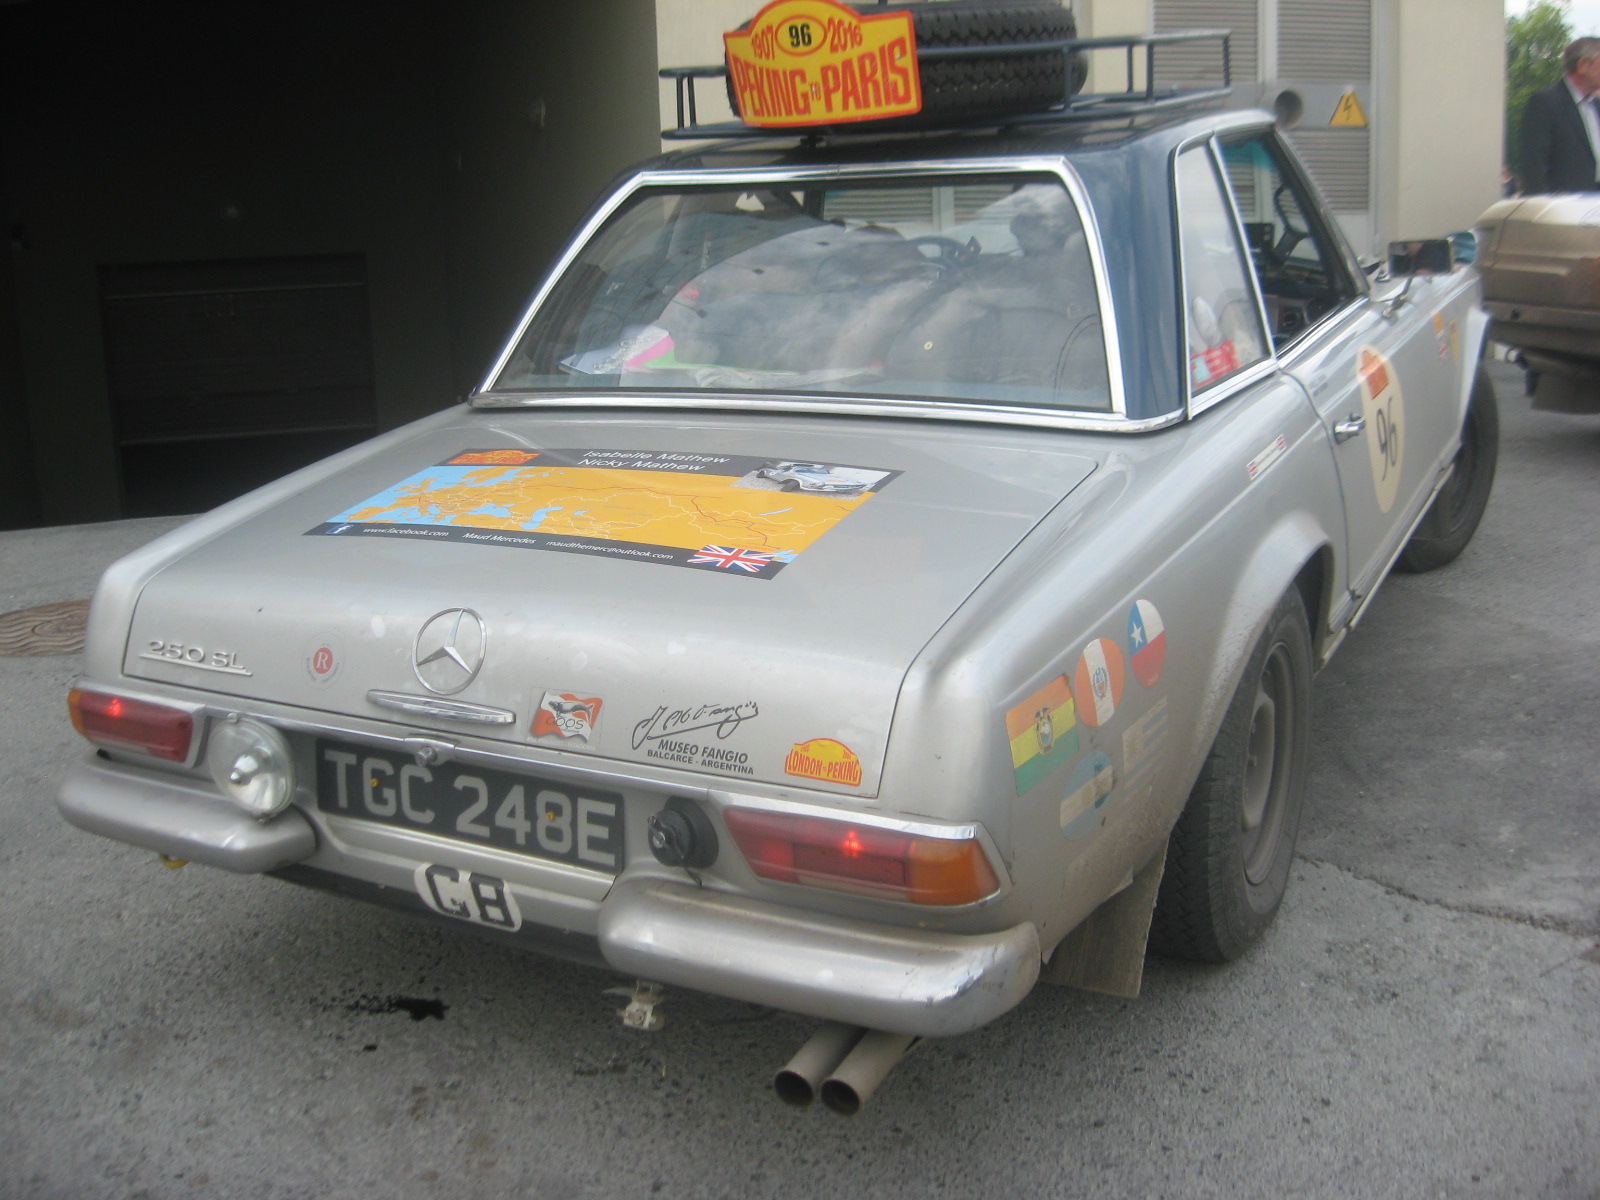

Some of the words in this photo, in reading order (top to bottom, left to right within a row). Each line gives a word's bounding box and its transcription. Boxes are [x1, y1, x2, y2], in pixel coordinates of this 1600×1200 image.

[751, 24, 775, 60] 1907
[788, 23, 812, 48] 96
[827, 16, 863, 53] 2016
[732, 54, 811, 118] PEKING
[821, 36, 912, 113] PARIS
[1376, 396, 1398, 482] 96
[577, 458, 629, 468] Nicky
[631, 460, 706, 472] Mathew
[584, 450, 653, 460] Isabelle
[656, 453, 731, 464] Mathew
[363, 528, 450, 537] www.facebook.com
[462, 532, 490, 541] Maud
[490, 534, 536, 545] Mercedes
[546, 540, 674, 560] maudthemerc@outlook.com
[148, 640, 206, 663] 250
[210, 651, 246, 669] SL
[316, 651, 330, 670] R
[647, 749, 694, 765] BALCARCE
[701, 759, 754, 775] ARGENTINA
[658, 739, 699, 756] MUSEO
[701, 746, 749, 765] FANGIO
[787, 750, 823, 776] LONDON
[826, 760, 860, 783] PEKING
[324, 749, 436, 825] TGC
[453, 774, 616, 867] 248E
